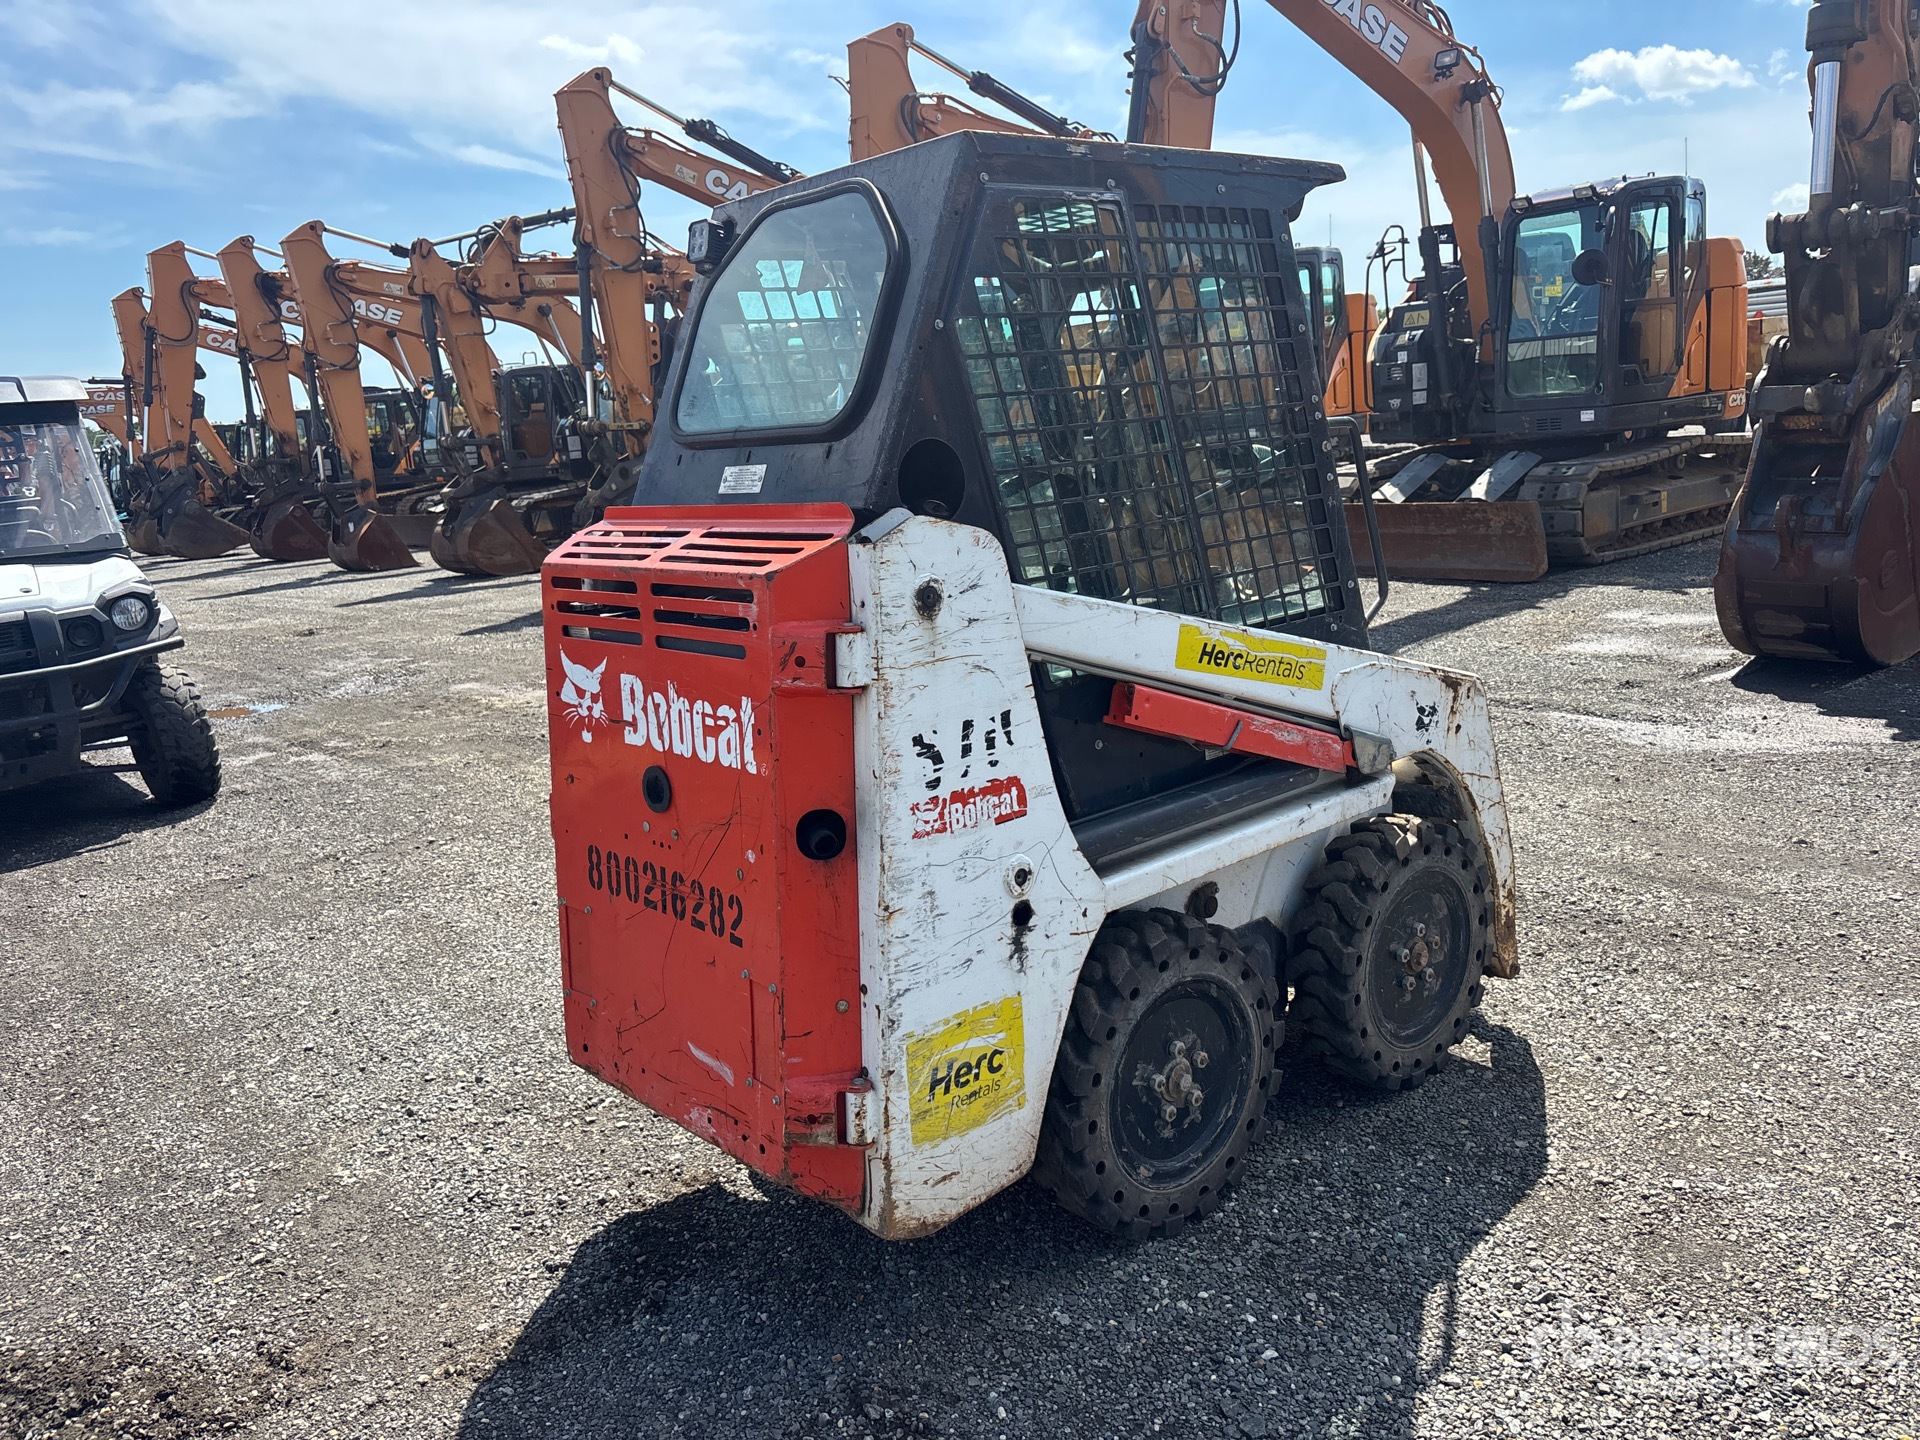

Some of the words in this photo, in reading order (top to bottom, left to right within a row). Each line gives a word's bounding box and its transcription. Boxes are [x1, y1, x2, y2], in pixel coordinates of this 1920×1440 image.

[1322, 0, 1410, 65] ASE
[705, 168, 763, 201] CA
[352, 298, 404, 326] ASE
[206, 333, 236, 353] CA
[93, 391, 125, 401] CAS
[1198, 642, 1306, 680] HercRentals
[620, 673, 757, 775] Bobcat
[949, 786, 1021, 832] Bobcat
[587, 844, 744, 949] 800216282
[927, 1048, 1006, 1103] Herc
[951, 1078, 1002, 1110] Rentals
